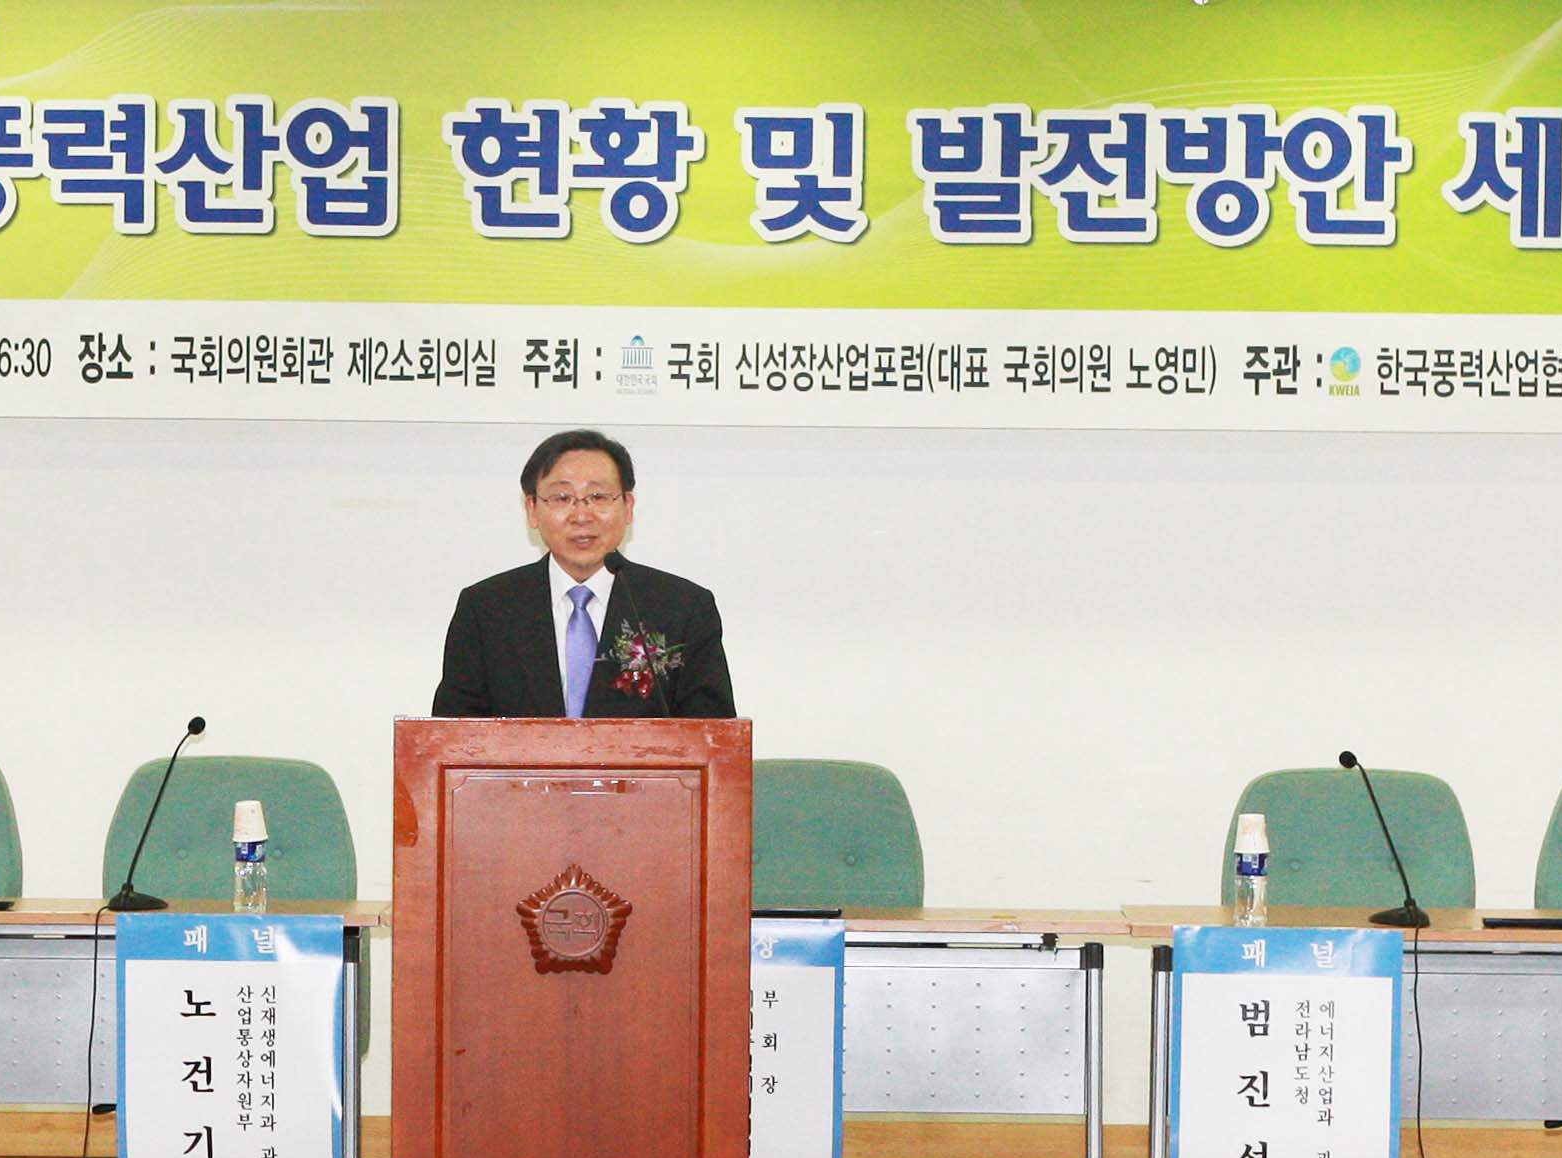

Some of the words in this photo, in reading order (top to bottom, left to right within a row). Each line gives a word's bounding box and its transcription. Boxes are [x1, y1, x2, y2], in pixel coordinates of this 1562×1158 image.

[449, 103, 699, 237] 현황
[743, 108, 859, 236] 및
[913, 108, 1408, 240] 발전방안
[76, 331, 135, 385] 장소
[169, 333, 335, 386] 국회의원회관
[346, 336, 497, 388] 제2소회의실
[522, 337, 580, 390] 주최
[666, 341, 721, 391] 국회
[734, 341, 991, 394] 신성장산업포럼(대표
[1002, 343, 1112, 394] 국회의원
[1125, 344, 1218, 396] 노영민)
[1242, 343, 1302, 397] 주관
[544, 908, 601, 944] 국회
[236, 985, 254, 1132] 산업통상자원부
[260, 985, 278, 1133] 신재생에너지과
[1293, 1000, 1311, 1105] 전라남도청
[1317, 1000, 1335, 1127] 에너지산업과
